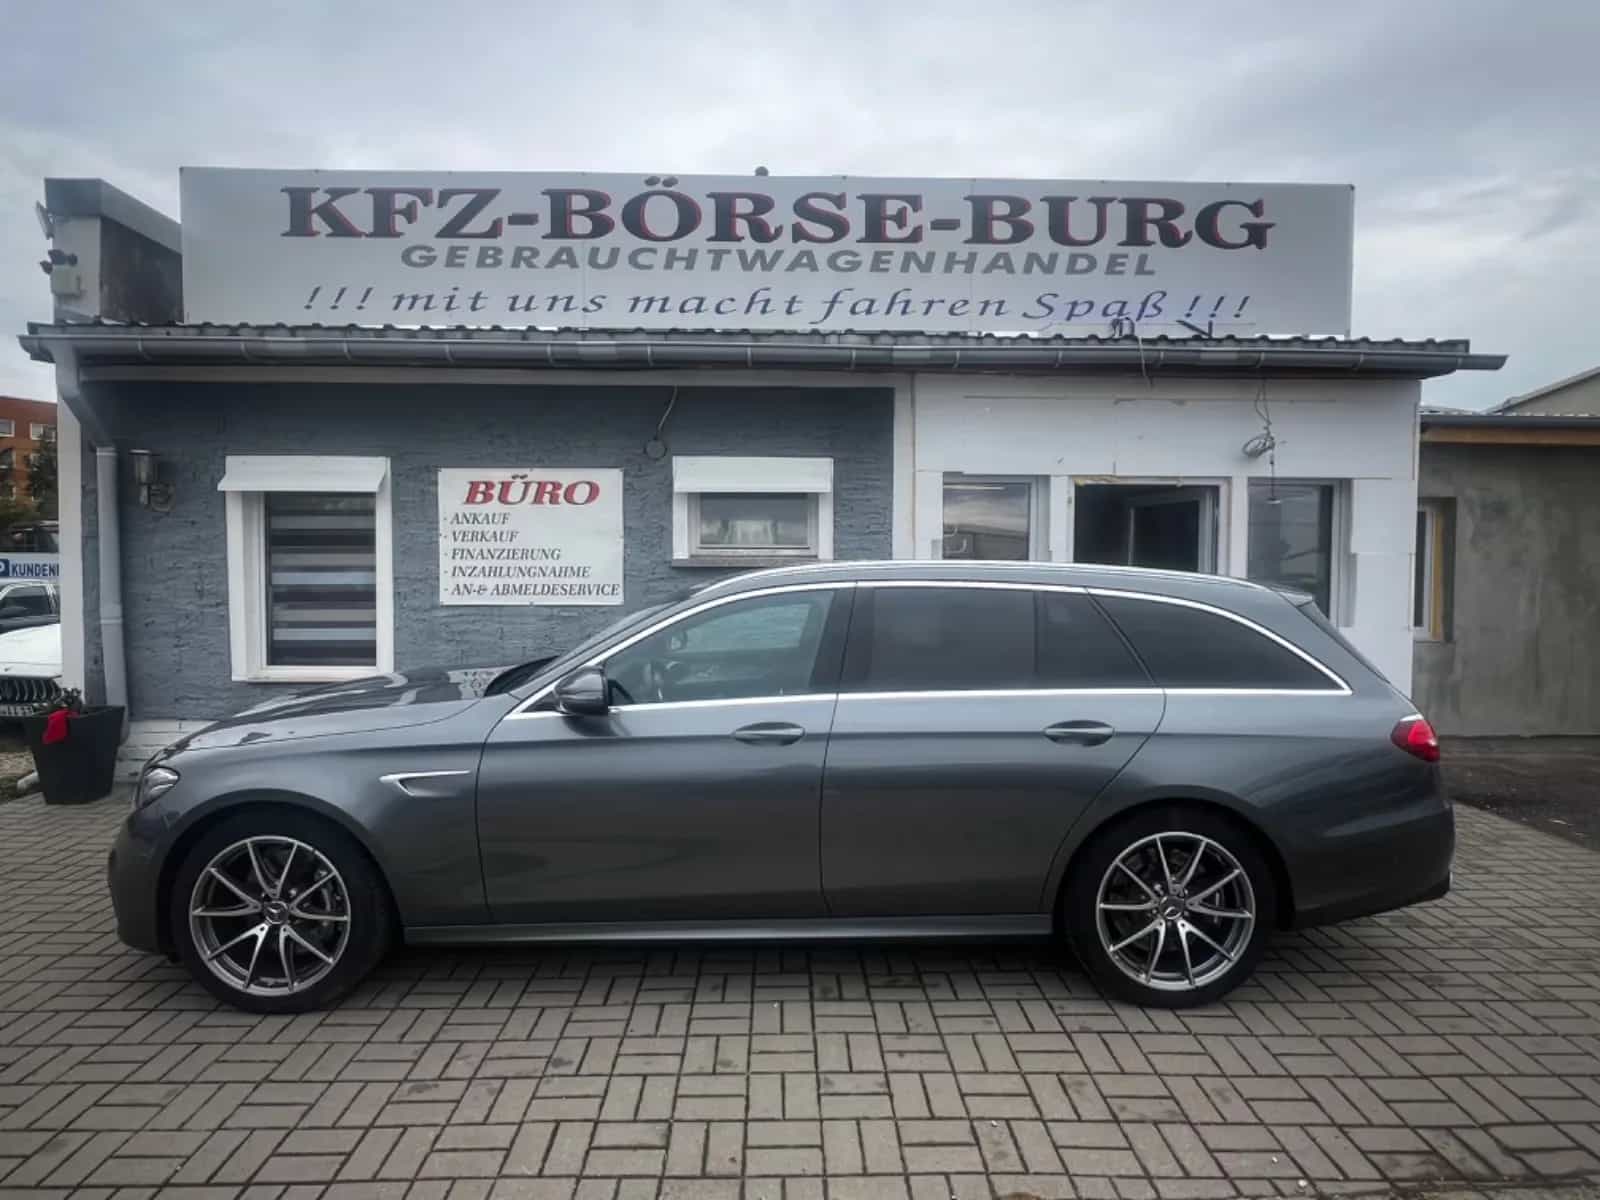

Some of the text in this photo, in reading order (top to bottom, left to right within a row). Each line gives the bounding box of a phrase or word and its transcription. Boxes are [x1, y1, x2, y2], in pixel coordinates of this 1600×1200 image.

[281, 175, 1276, 250] KFZ-BÖRSE-BURG
[401, 244, 1157, 276] GEBRAUCHTWAGENHANDEL
[392, 287, 488, 313] mit
[506, 294, 607, 314] uns
[628, 287, 803, 316] macht
[809, 288, 1009, 325] fahren
[1022, 290, 1168, 323] Spaß
[463, 474, 600, 505] BÜRO
[451, 512, 510, 525] ANKAUF
[451, 530, 519, 543] VERKAUF
[451, 548, 561, 560] FINANZIERUNG
[451, 566, 591, 578] INZAHLUNGNAHME
[491, 583, 621, 596] ABMELDESERVICE
